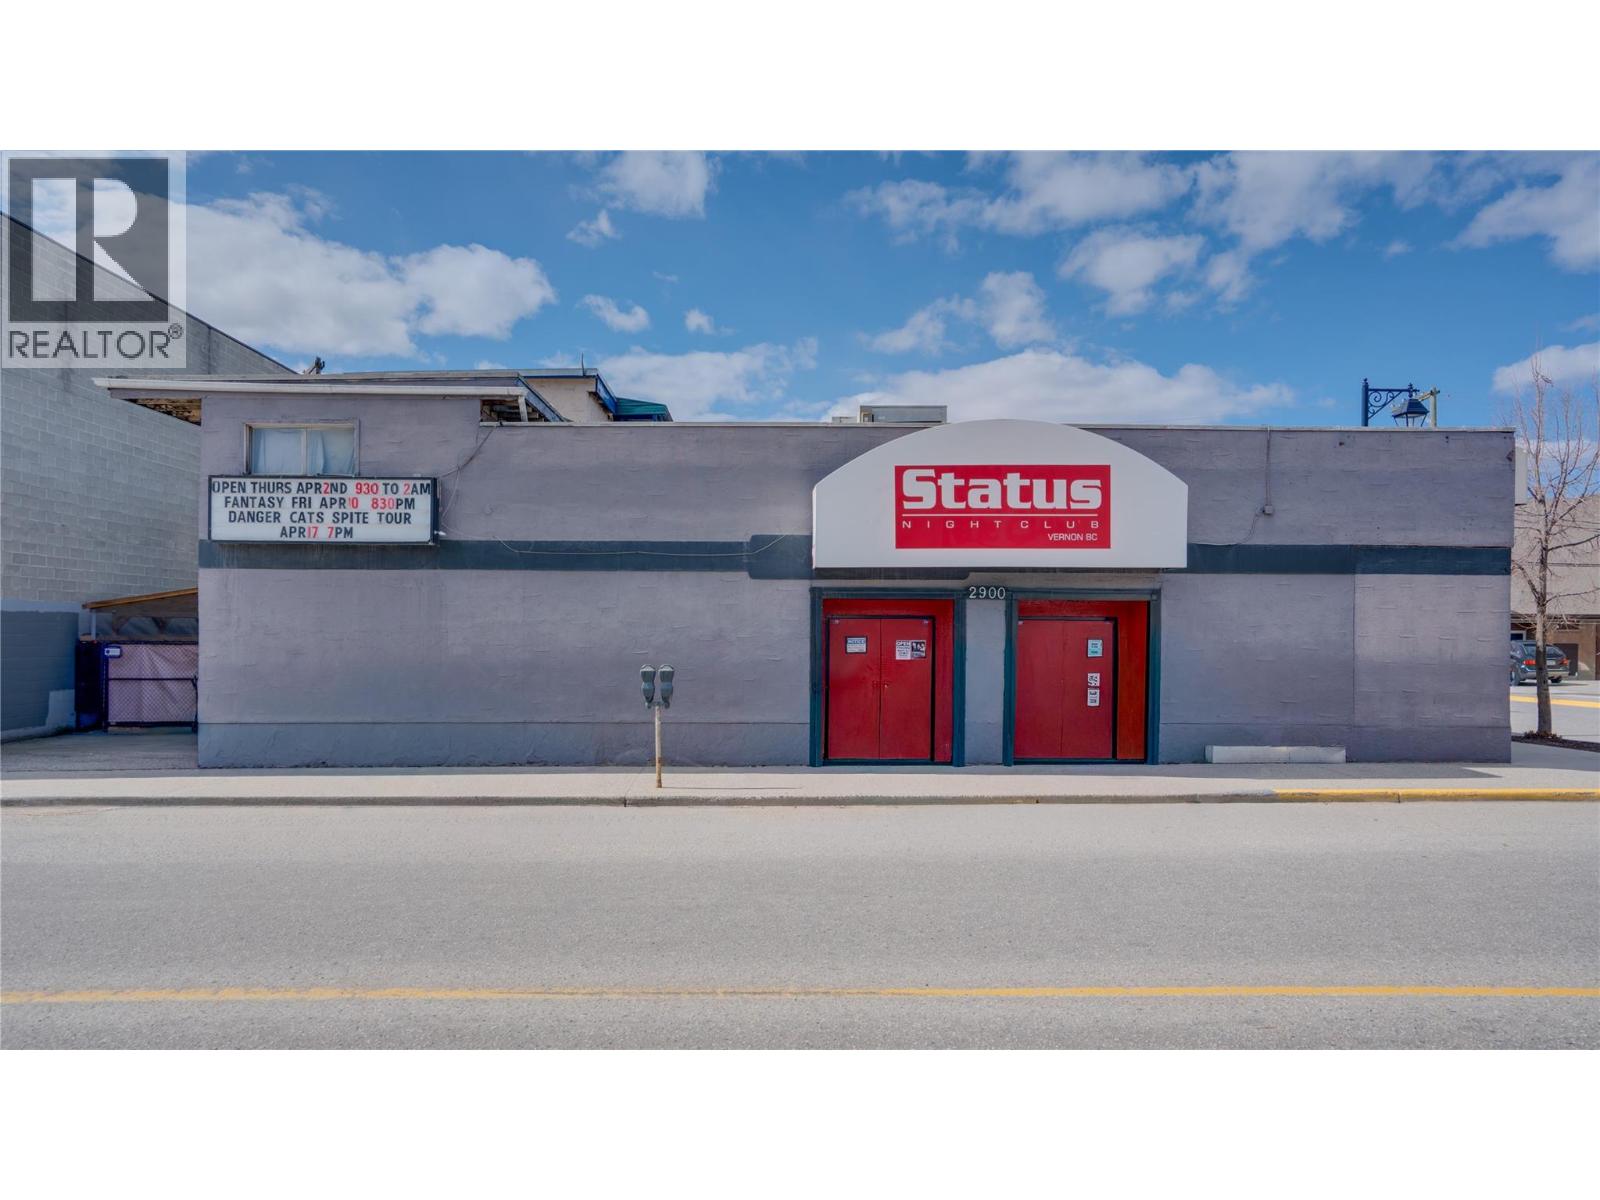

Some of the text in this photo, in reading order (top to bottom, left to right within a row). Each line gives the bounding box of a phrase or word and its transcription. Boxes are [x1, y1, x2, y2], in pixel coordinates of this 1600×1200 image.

[212, 481, 431, 495] OPEN THURS APR2ND 930 TO 2AM
[902, 468, 1102, 510] Status
[224, 496, 284, 509] FANTASY
[291, 496, 312, 509] FRI
[371, 497, 415, 510] 830PM
[228, 510, 412, 525] DANGER CATS SPITE TOUR
[280, 526, 353, 539] APR17 7PM
[1048, 532, 1098, 541] VERNON BC
[968, 586, 1006, 600] 2900
